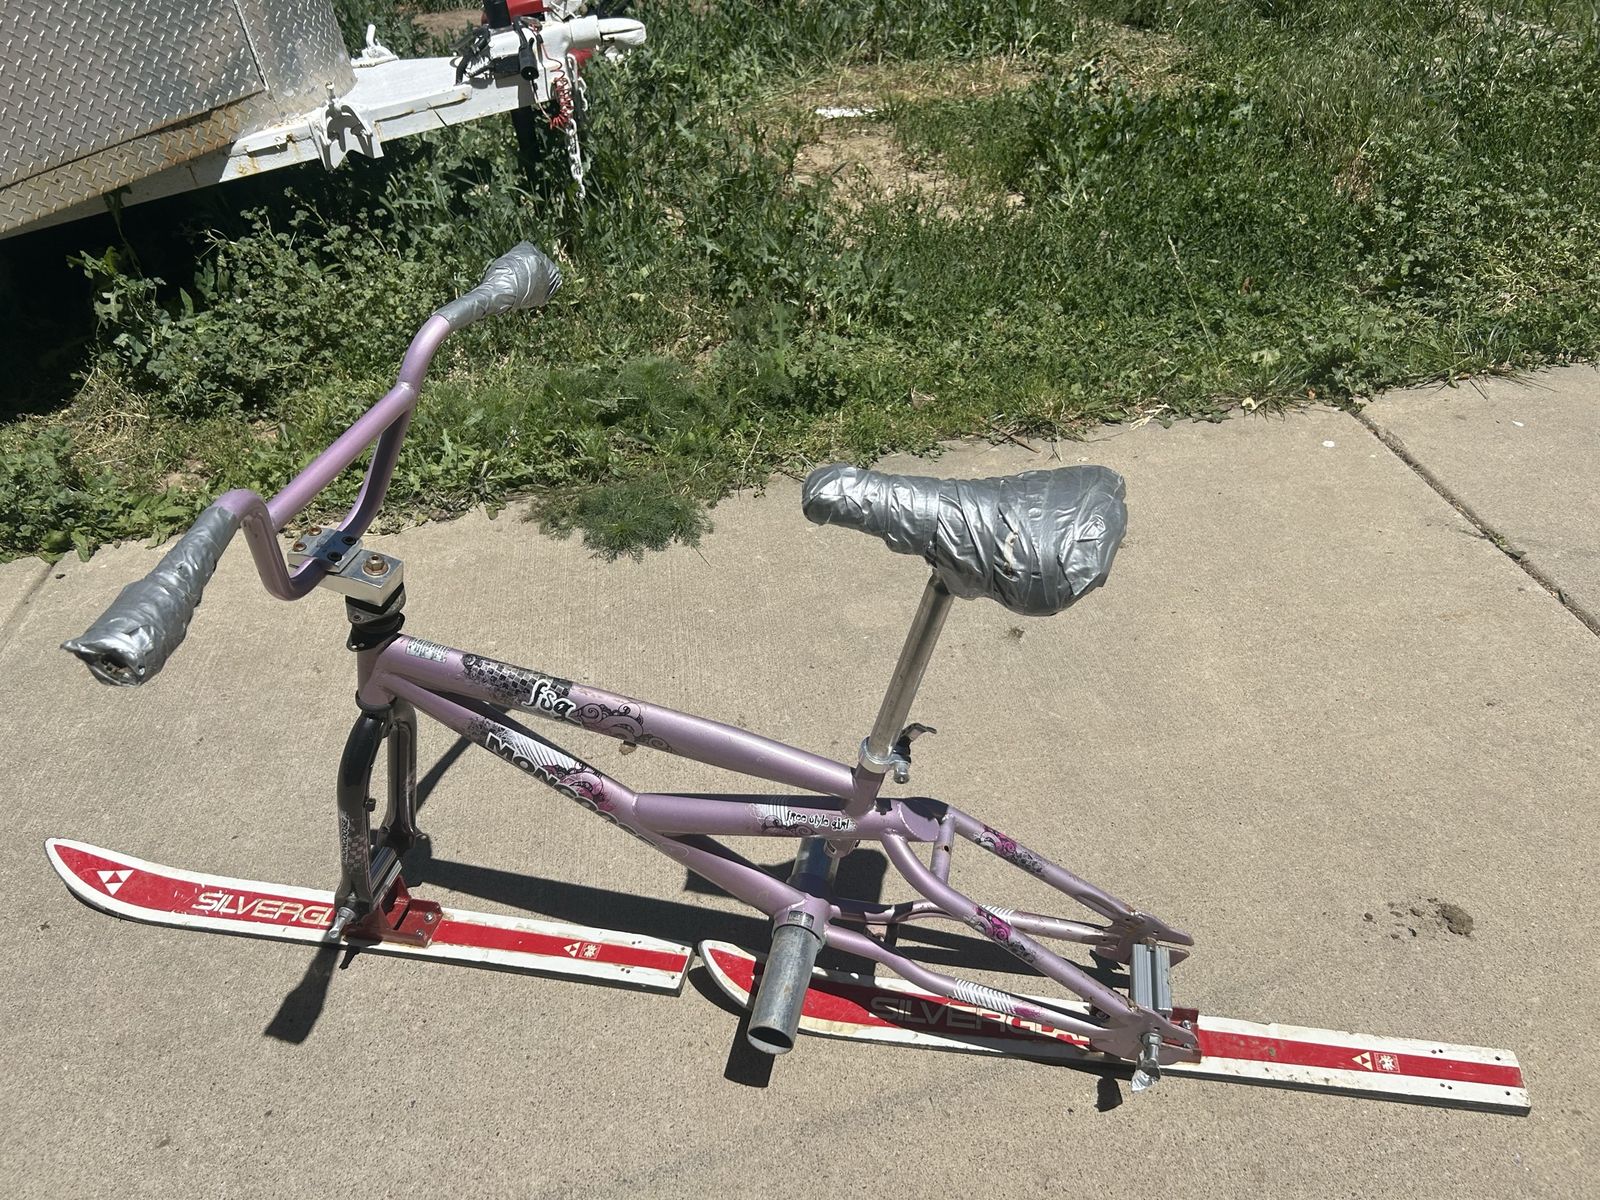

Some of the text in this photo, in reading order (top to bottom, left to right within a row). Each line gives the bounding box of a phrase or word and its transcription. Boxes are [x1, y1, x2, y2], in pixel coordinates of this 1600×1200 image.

[786, 811, 807, 823] free
[831, 817, 850, 831] girl
[191, 891, 335, 926] SILVERGL
